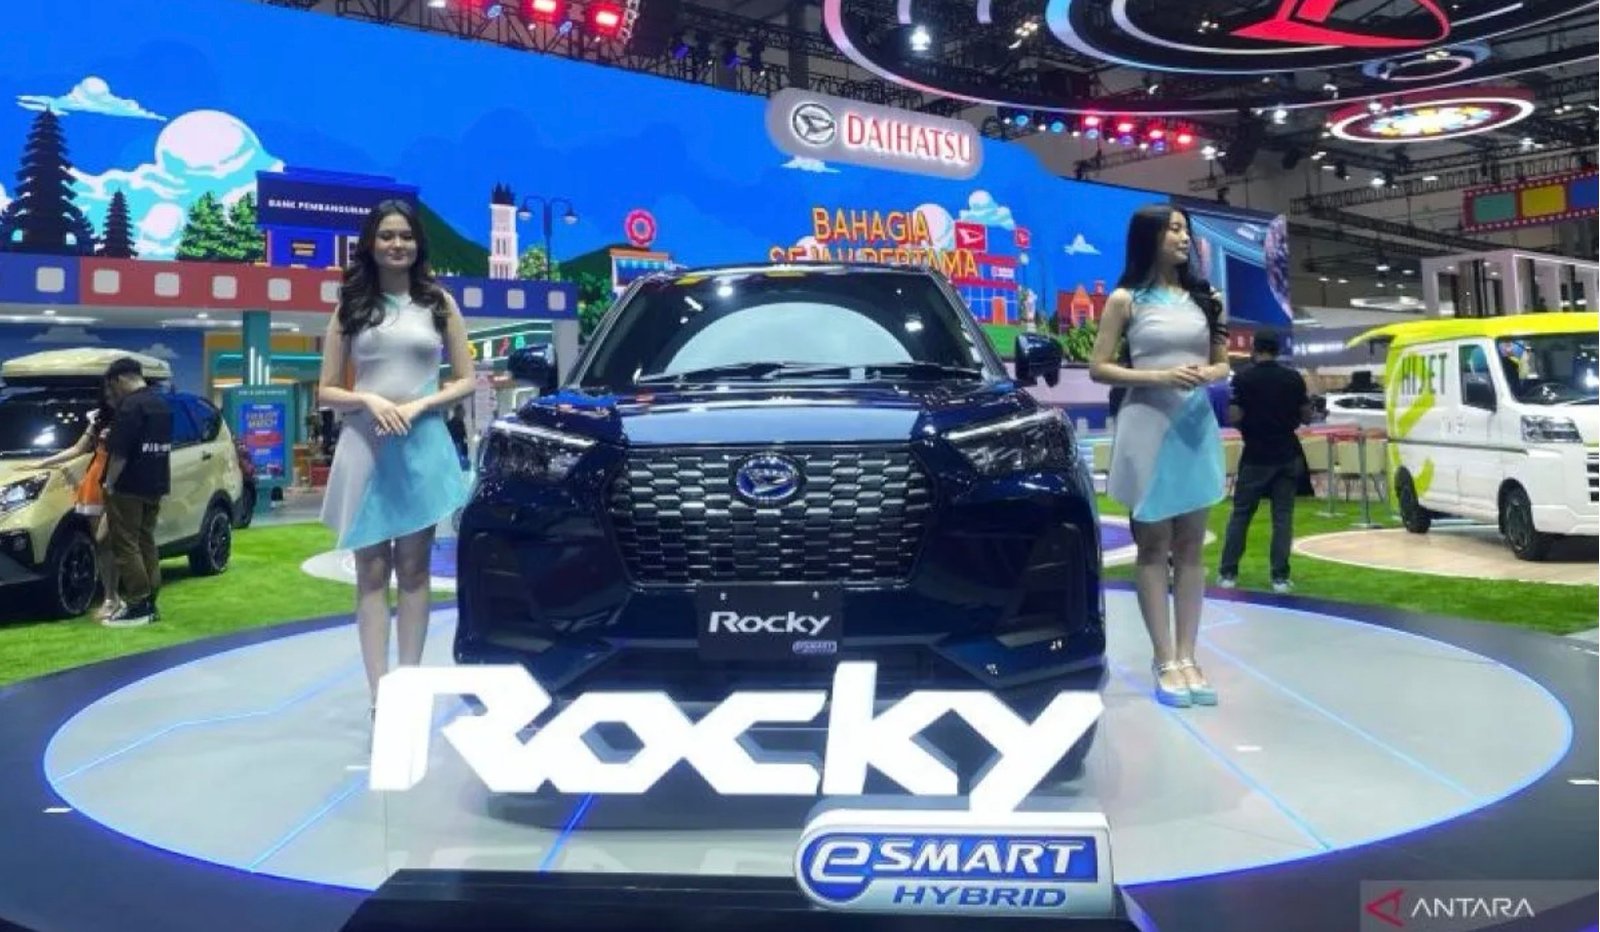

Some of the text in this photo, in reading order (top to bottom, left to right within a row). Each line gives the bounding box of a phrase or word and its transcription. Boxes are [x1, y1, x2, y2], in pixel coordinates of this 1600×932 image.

[846, 112, 973, 164] DAIHATSU
[268, 200, 295, 209] BANK
[811, 206, 932, 245] BAHAGIA
[1401, 352, 1448, 396] HIJET
[708, 610, 832, 636] Rocky
[368, 660, 1105, 816] Rocky
[892, 885, 1067, 908] HYBRID
